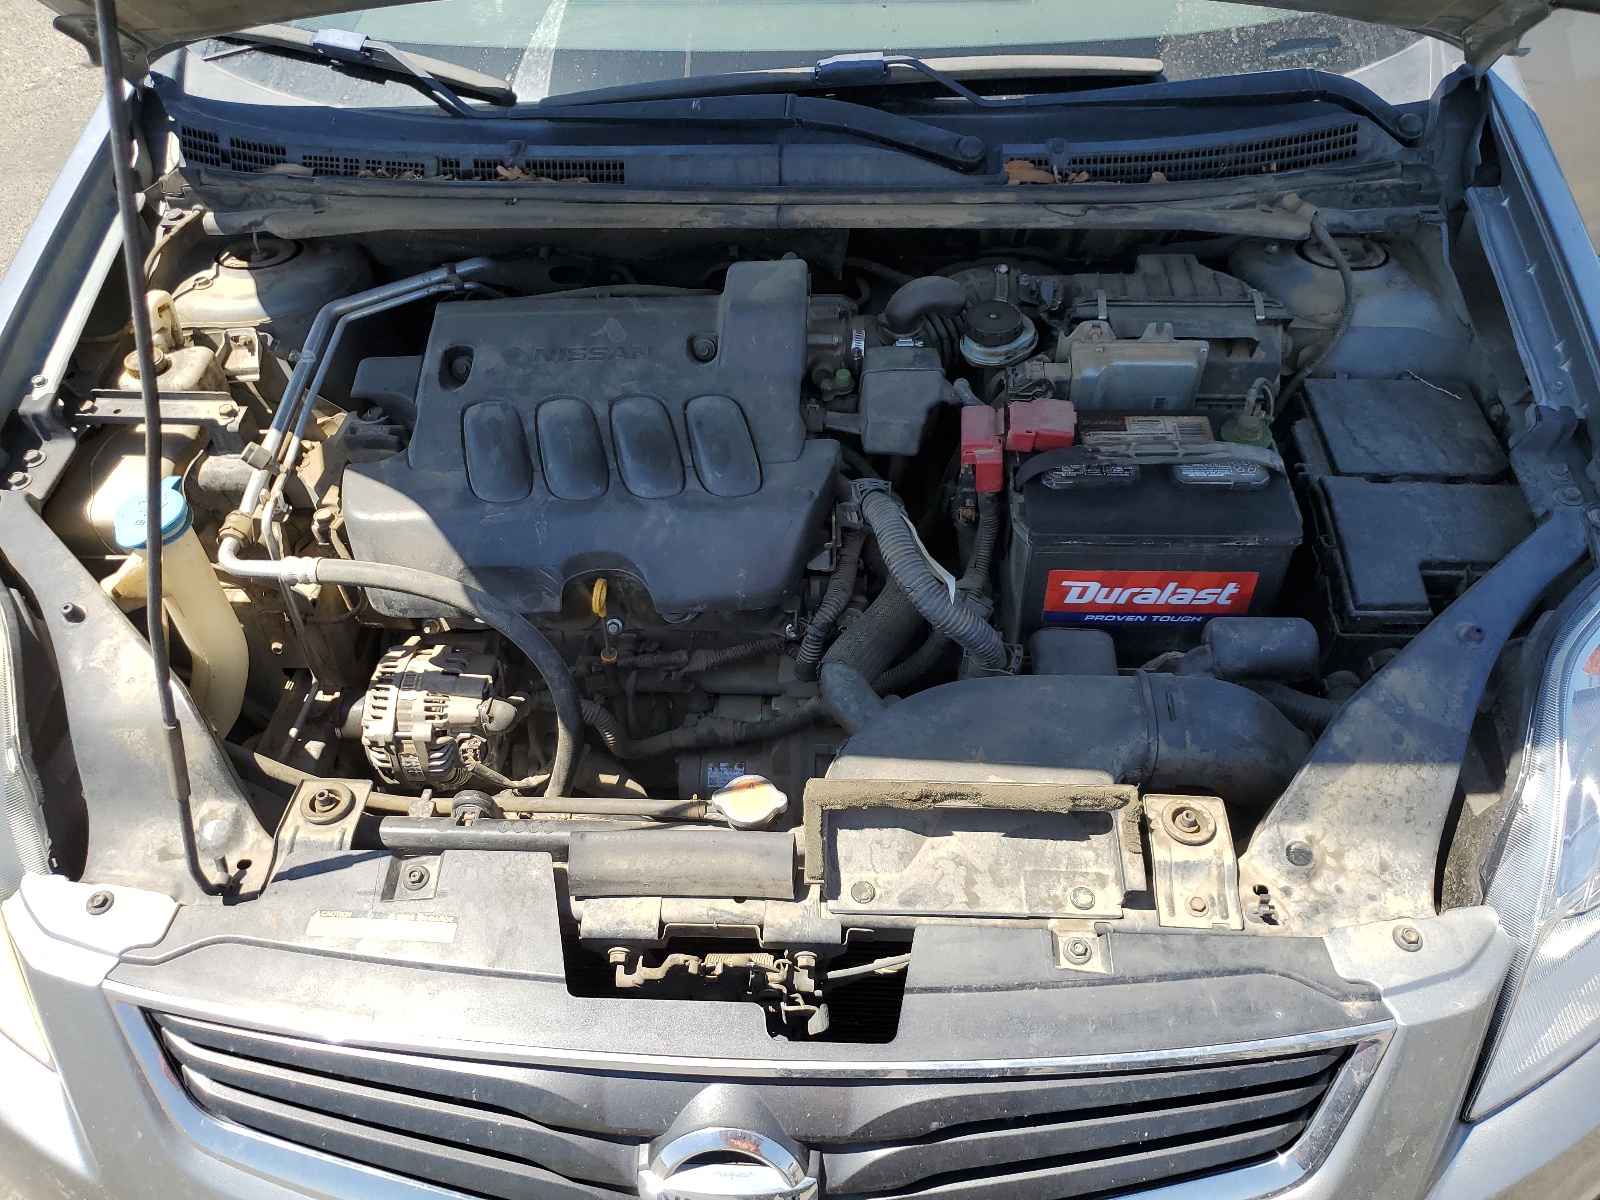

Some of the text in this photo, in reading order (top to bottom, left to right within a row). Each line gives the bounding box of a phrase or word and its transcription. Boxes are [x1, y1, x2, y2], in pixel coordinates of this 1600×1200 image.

[534, 346, 655, 362] NISSAN
[1061, 581, 1240, 605] Duralast
[1084, 614, 1202, 623] PROVEN TOUGH
[321, 910, 353, 919] CAUTION
